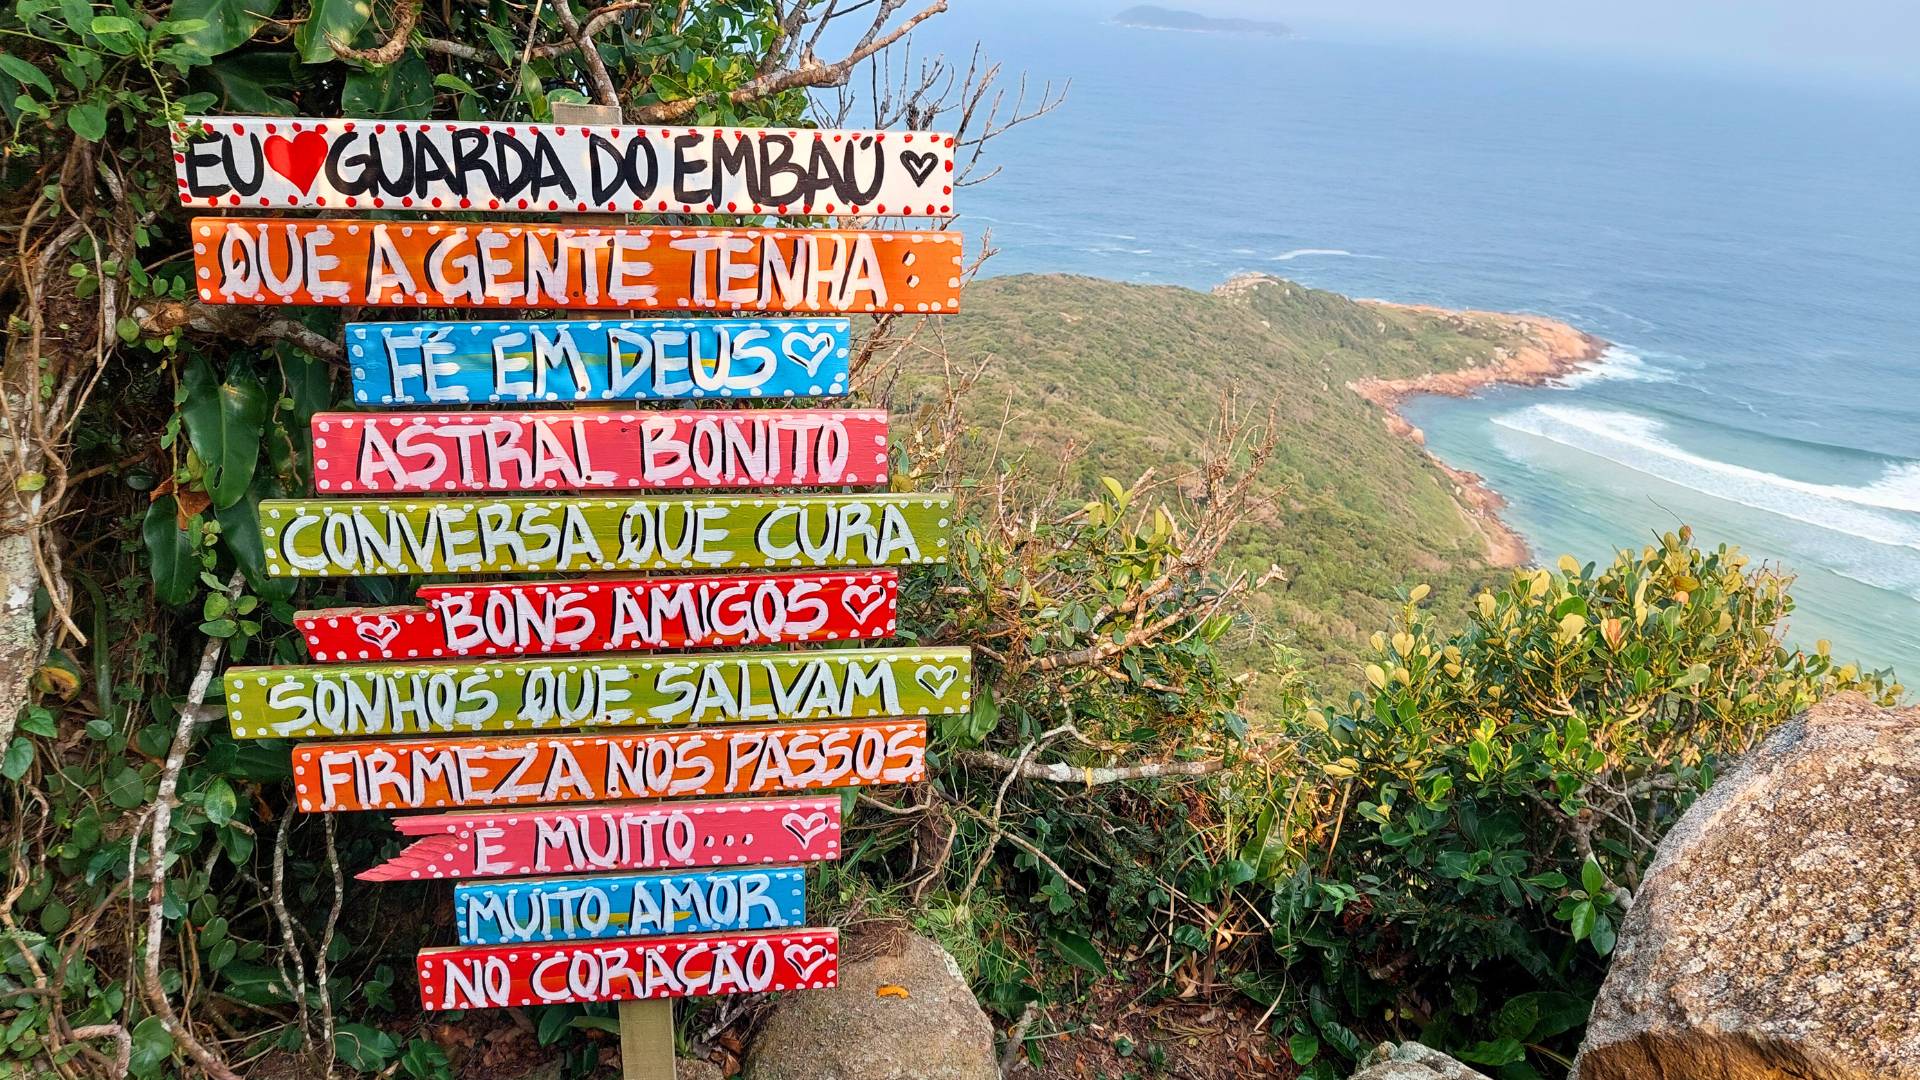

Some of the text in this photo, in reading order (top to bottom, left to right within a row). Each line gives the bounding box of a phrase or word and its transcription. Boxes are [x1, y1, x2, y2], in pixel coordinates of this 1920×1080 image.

[186, 129, 885, 208] EU GUARDA DO EMBAÚ
[219, 224, 349, 301] QUE
[365, 225, 416, 303] A
[425, 230, 658, 306] GENTE
[669, 235, 889, 310] TENHA
[383, 323, 777, 402] FÉ EM DEUS
[357, 417, 848, 490] ASTRAL BONITO
[280, 500, 922, 571] CONVERSA QUE CURA
[440, 581, 829, 652] BONS AMIGOS
[267, 658, 900, 736] SONHOS QUE SALVAM
[320, 728, 924, 811] FIRMEZA NOS PASSOS
[466, 874, 781, 942] MUITO AMOR
[442, 940, 775, 1010] NO CORAÇÃO
